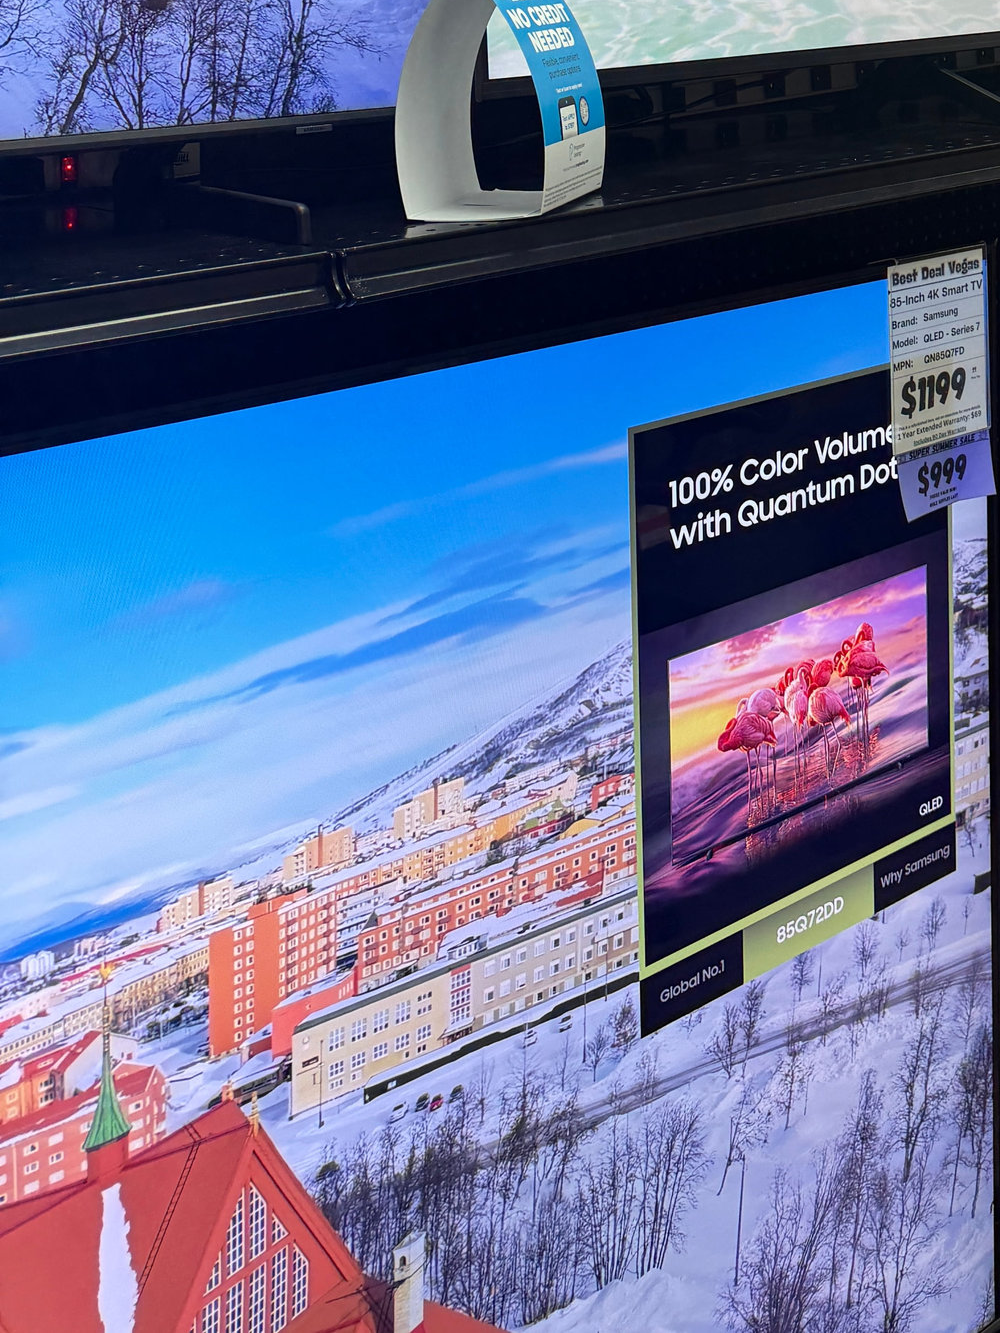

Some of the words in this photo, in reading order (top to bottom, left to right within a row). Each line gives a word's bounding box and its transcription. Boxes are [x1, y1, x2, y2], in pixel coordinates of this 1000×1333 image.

[506, 7, 532, 30] NO
[527, 3, 570, 27] CREDIT
[527, 27, 575, 53] NEEDED
[892, 269, 918, 286] Best
[921, 263, 945, 280] Deal
[948, 258, 980, 275] Vegas
[890, 290, 925, 309] 85-Inch
[927, 289, 940, 299] 4K
[941, 283, 968, 297] Smart
[970, 279, 983, 290] TV
[892, 317, 918, 330] Brand:
[923, 307, 959, 322] Samsung
[892, 337, 918, 350] Model:
[923, 330, 944, 343] QLED
[951, 324, 975, 337] Series
[975, 321, 980, 331] 7
[893, 359, 914, 373] MPN:
[924, 346, 965, 364] QN85Q7FD
[900, 367, 967, 419] $1199
[902, 430, 916, 439] Year
[916, 423, 943, 435] Extended
[943, 414, 971, 427] Warranty:
[909, 446, 930, 460] SUPER
[931, 439, 958, 453] SUMMER
[959, 434, 975, 445] SALE
[668, 464, 735, 508] 100%
[738, 446, 809, 487] Color
[813, 424, 893, 465] Volume
[917, 453, 967, 497] $999
[669, 508, 732, 550] with
[737, 471, 855, 528] Quantum
[859, 456, 899, 488] Dot
[918, 795, 944, 816] QLED
[880, 867, 903, 889] Why
[904, 843, 951, 877] Samsung
[776, 896, 845, 945] 85Q72DD
[659, 972, 701, 1003] Global
[702, 959, 726, 983] No.1
